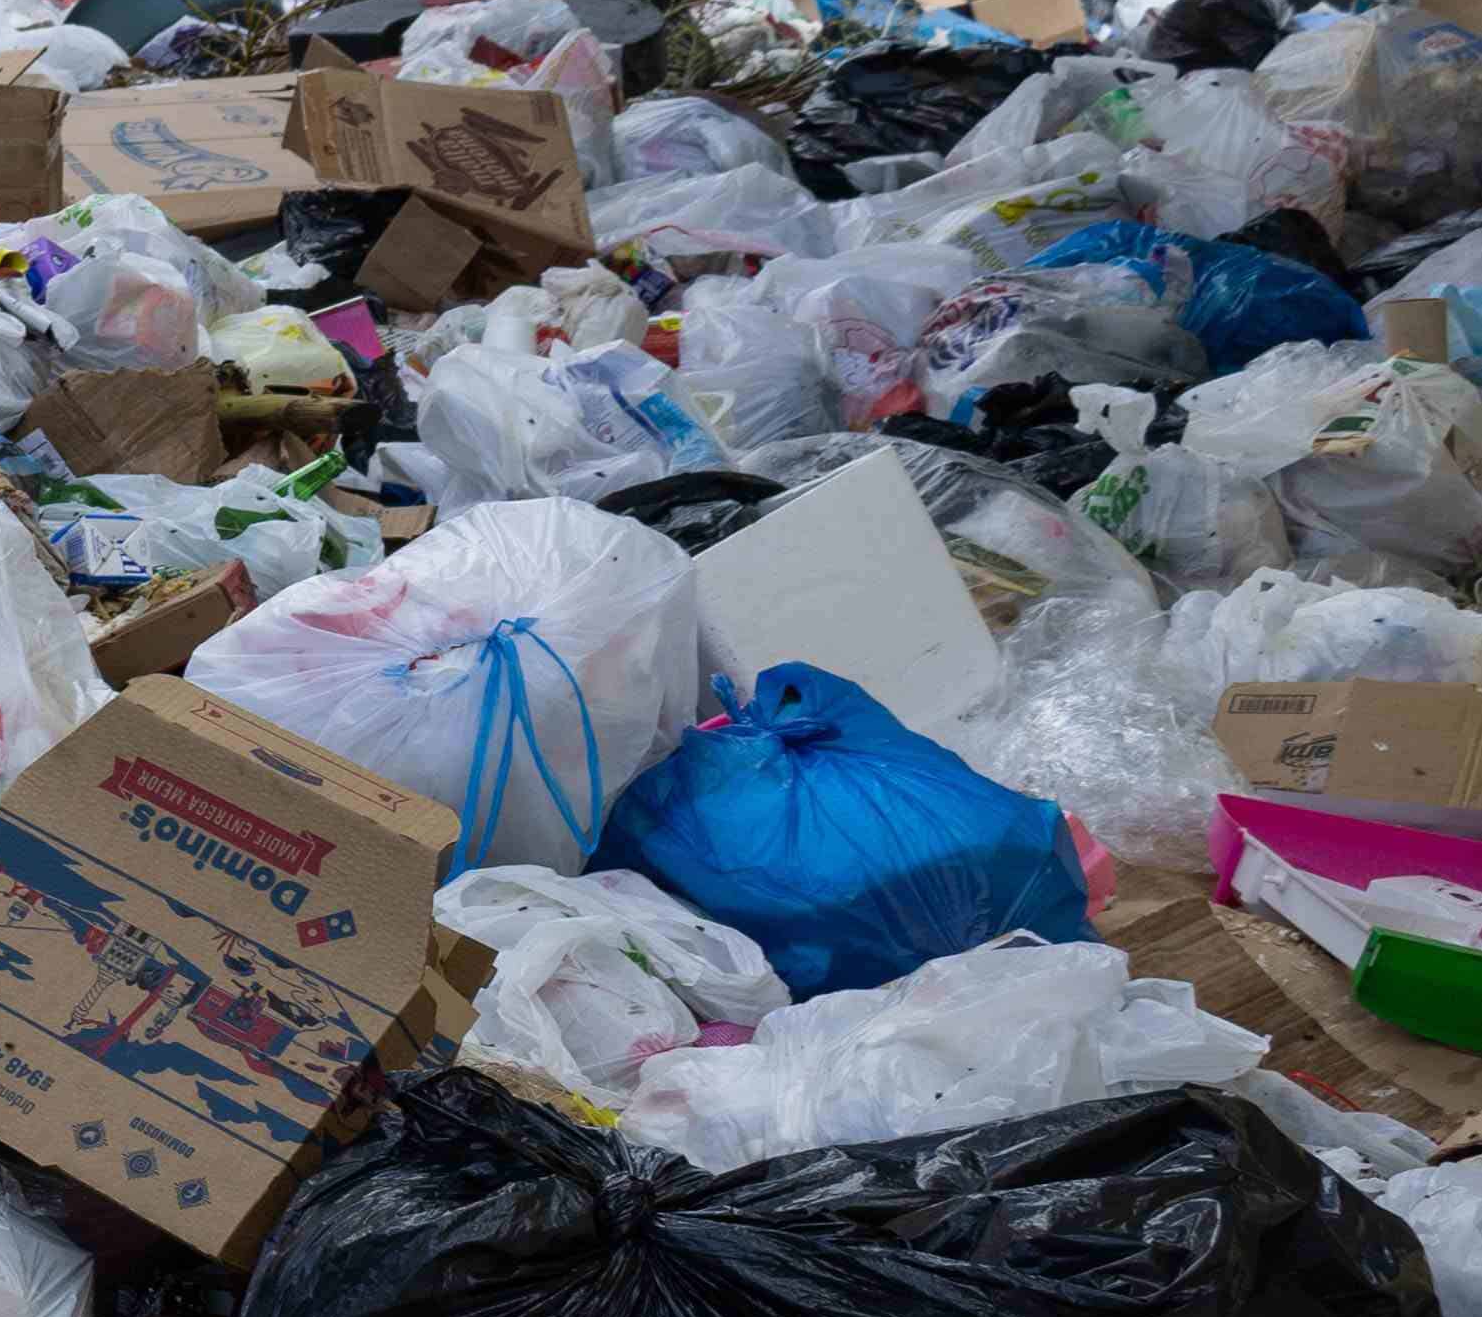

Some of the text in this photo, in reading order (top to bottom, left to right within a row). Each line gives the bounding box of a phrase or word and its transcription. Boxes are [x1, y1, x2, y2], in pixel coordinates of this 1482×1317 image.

[128, 802, 310, 917] Domino's
[136, 769, 303, 863] NADIE ENTREGA MEJOR
